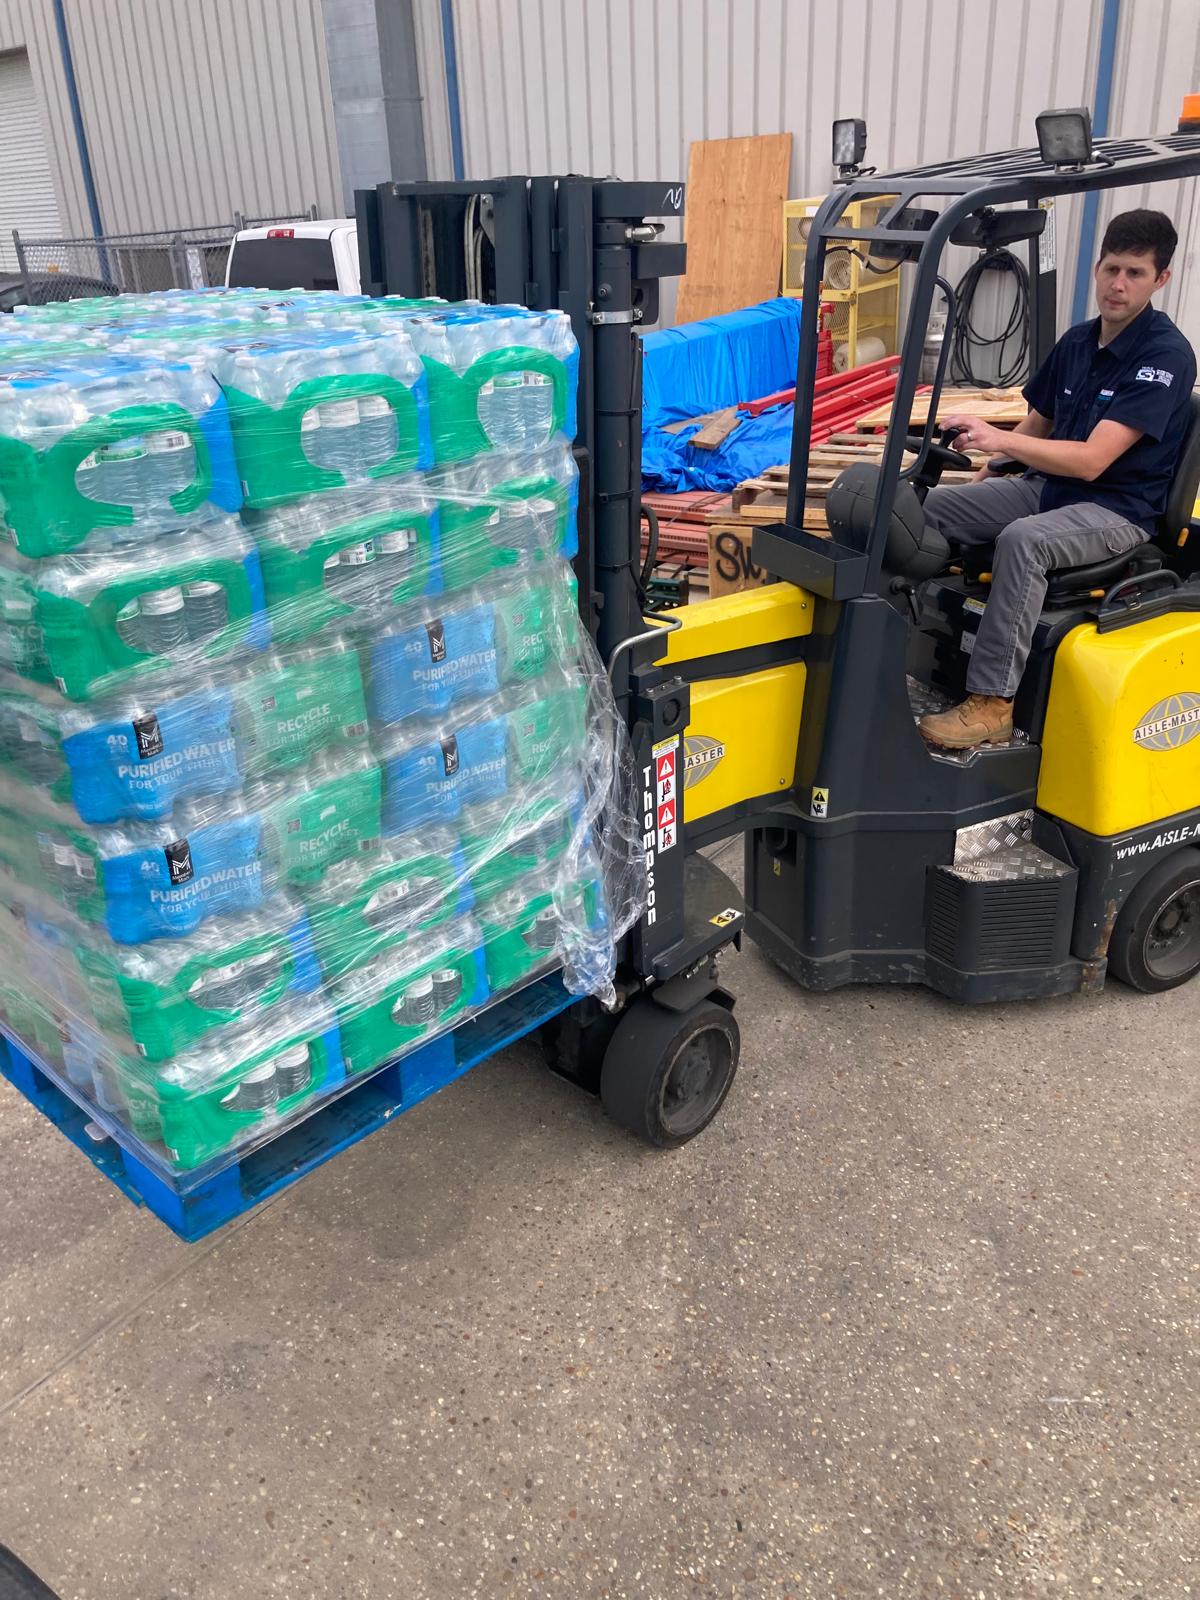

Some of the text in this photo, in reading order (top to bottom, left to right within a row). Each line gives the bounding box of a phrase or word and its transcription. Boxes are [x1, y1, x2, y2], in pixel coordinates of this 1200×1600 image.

[458, 649, 497, 668] WATER
[277, 703, 331, 734] RECYCLE
[1134, 708, 1199, 741] AISLE-MAST
[107, 735, 128, 746] 40
[118, 738, 236, 778] PURIFIED WATER
[470, 756, 507, 775] WATER
[684, 746, 724, 769] ASTER
[129, 779, 153, 790] FOR
[154, 767, 183, 786] YOUR
[300, 819, 350, 853] RECYCLE
[643, 765, 656, 926] Thompson
[140, 860, 160, 873] 40
[150, 861, 262, 903] PURIFIED WATER
[161, 902, 183, 913] FOR
